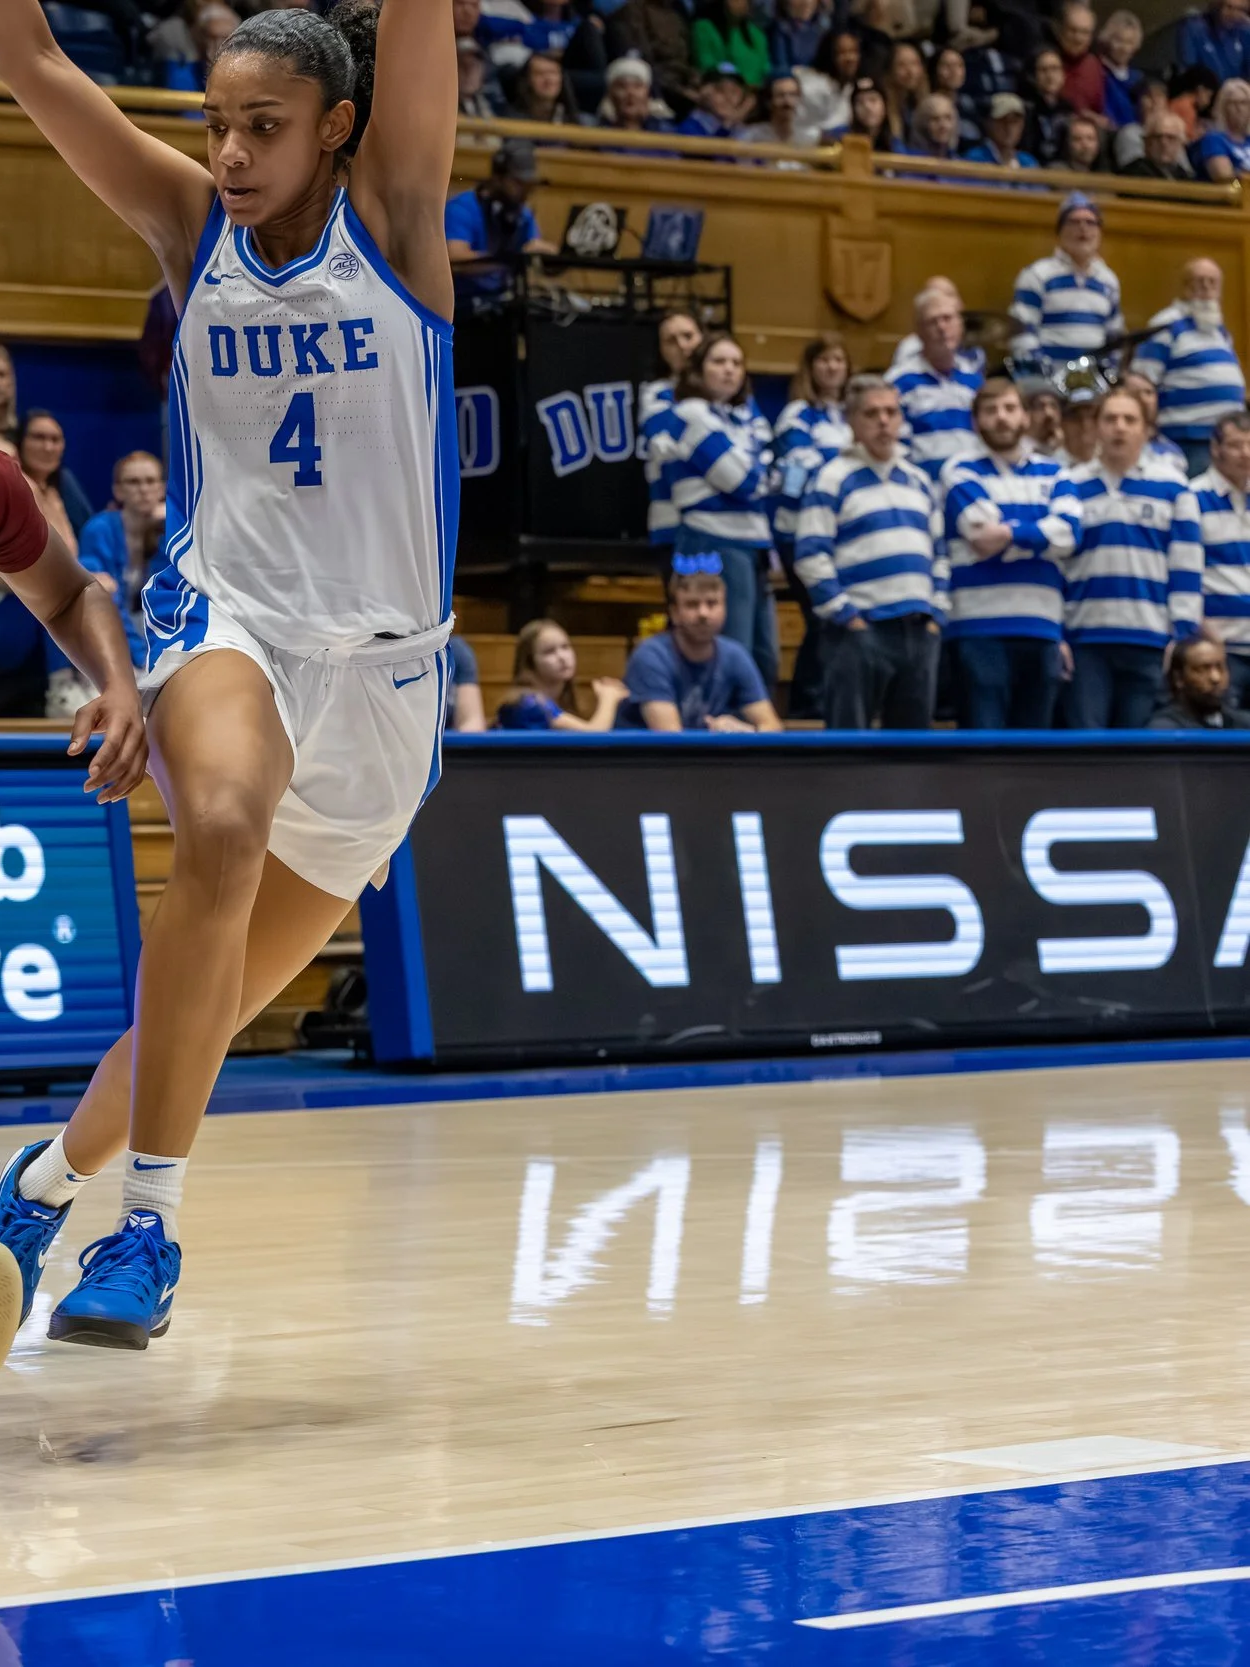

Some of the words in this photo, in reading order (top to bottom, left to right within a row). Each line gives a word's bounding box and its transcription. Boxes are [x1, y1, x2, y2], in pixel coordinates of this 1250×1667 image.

[208, 317, 379, 377] DUKE
[269, 392, 323, 487] 4
[503, 807, 1250, 992] NISS
